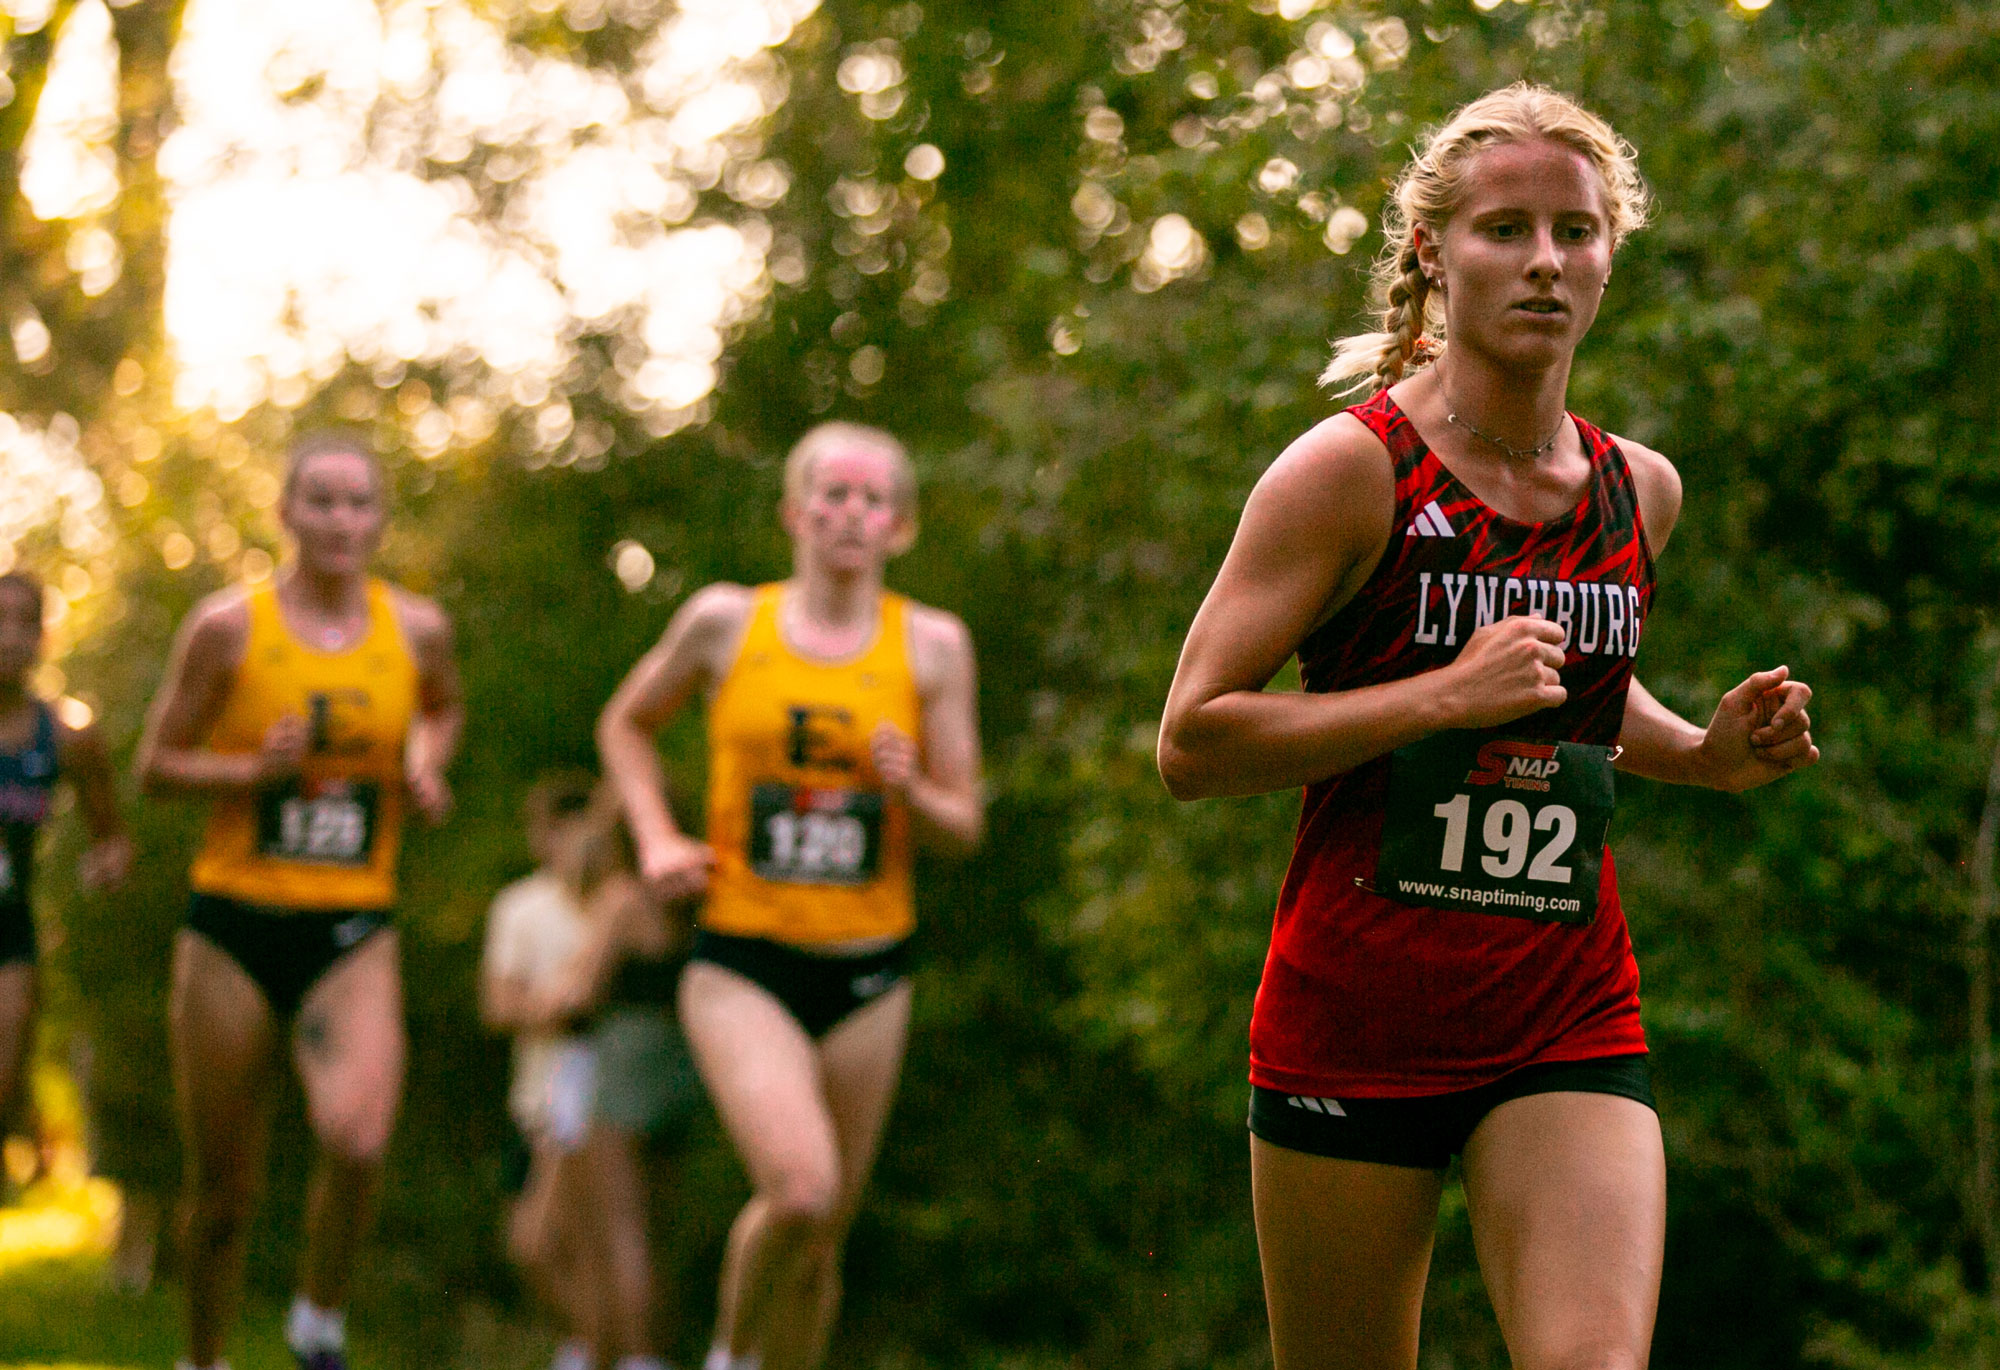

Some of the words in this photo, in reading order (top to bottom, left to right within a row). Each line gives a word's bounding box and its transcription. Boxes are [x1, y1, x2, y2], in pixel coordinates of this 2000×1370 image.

[1414, 571, 1640, 658] LYNCHBURG
[307, 690, 376, 756] E
[788, 705, 857, 772] E
[1464, 740, 1561, 786] SNAP
[1504, 776, 1550, 792] TIMING
[1433, 793, 1577, 884] 192
[1398, 880, 1581, 913] www.snaptiming.com
